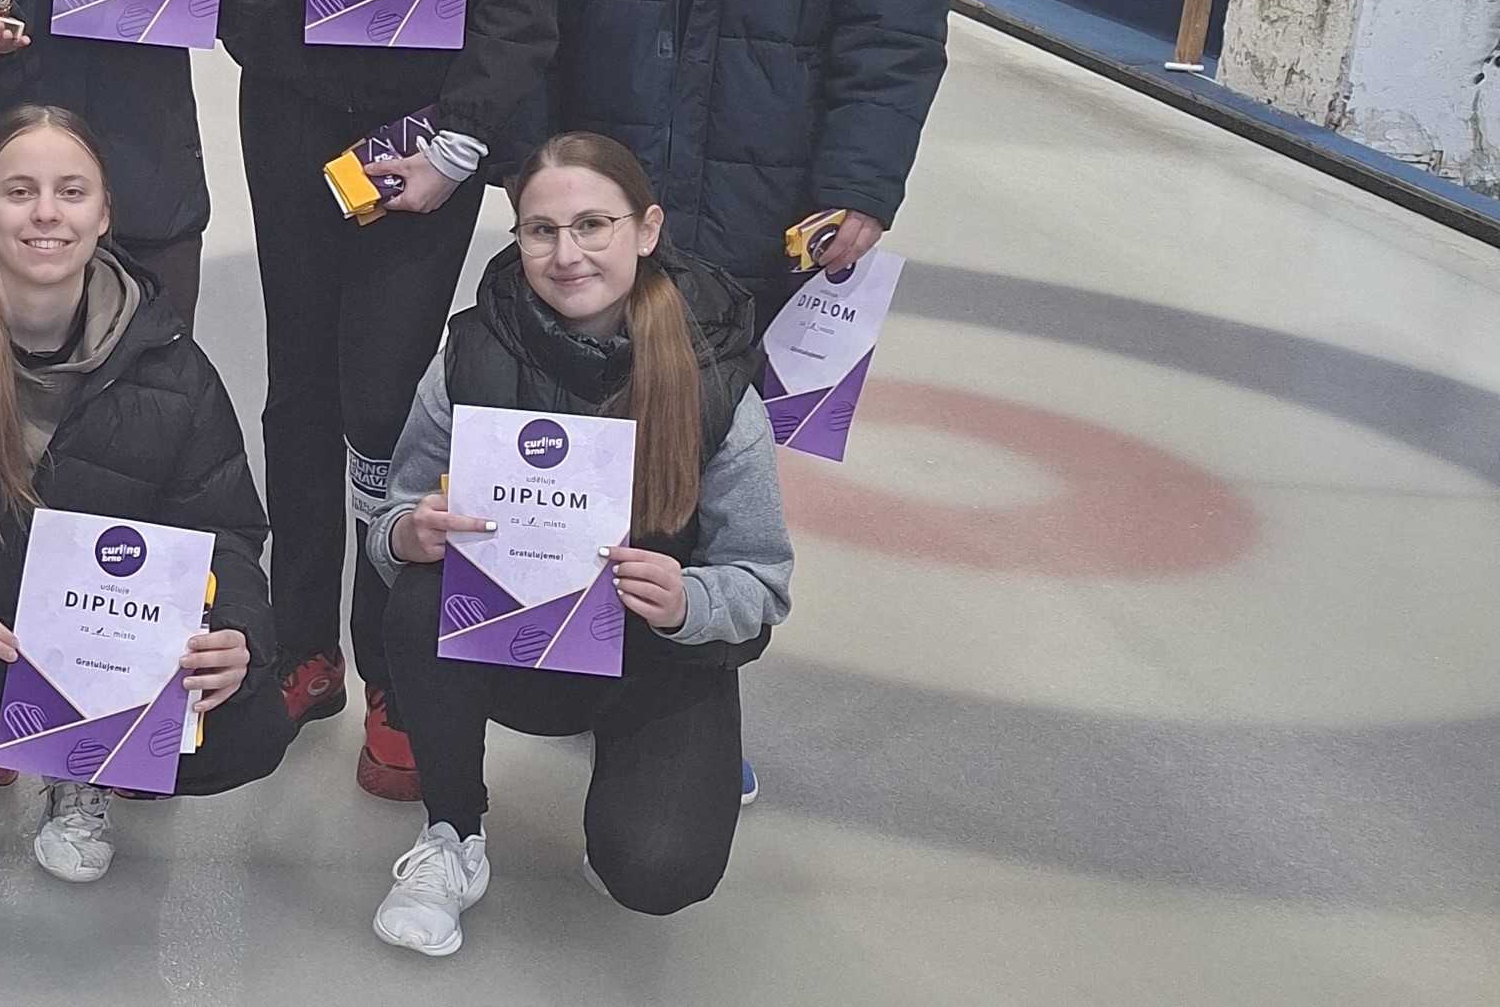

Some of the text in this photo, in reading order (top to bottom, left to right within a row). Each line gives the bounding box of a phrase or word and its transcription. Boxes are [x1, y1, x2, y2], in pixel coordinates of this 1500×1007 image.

[797, 294, 856, 323] DIPLOM
[493, 485, 588, 510] DIPLOM
[509, 548, 564, 562] Gratulujeme!
[65, 591, 161, 623] DIPLOM
[76, 657, 130, 674] Gratulujeme!
